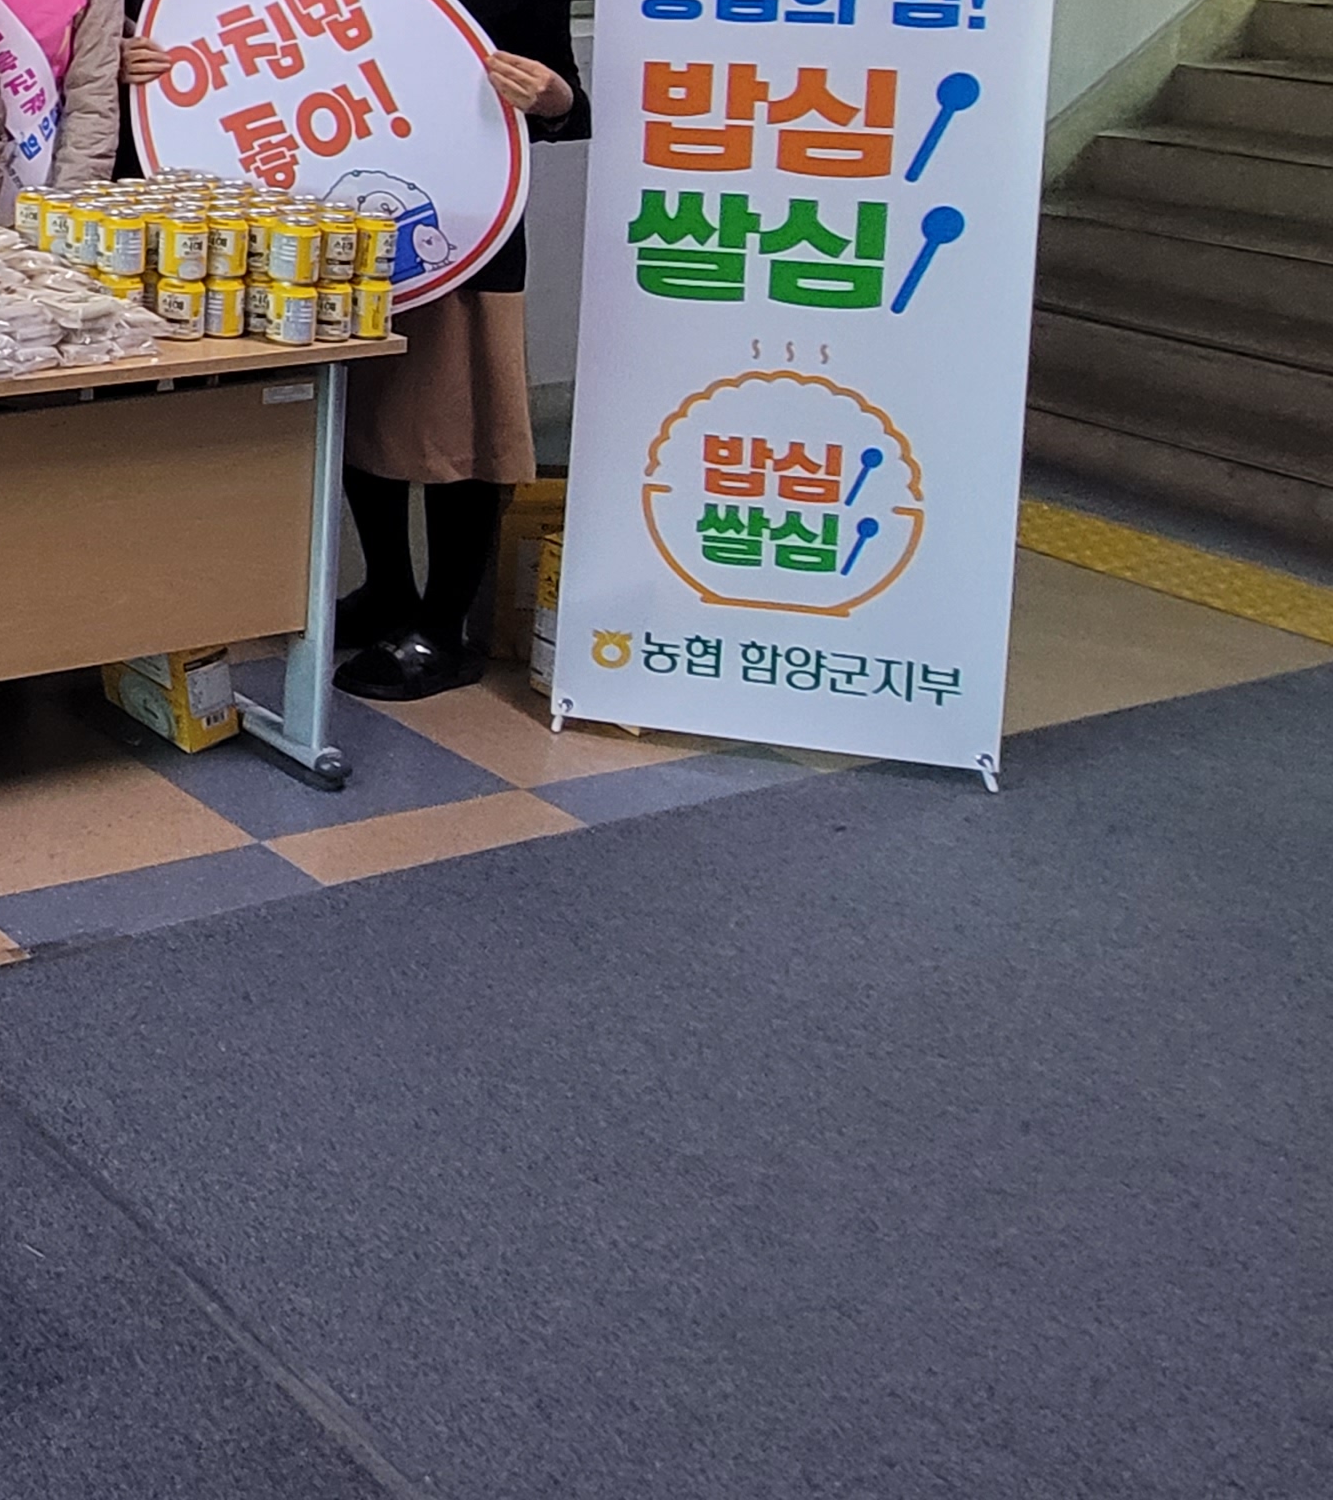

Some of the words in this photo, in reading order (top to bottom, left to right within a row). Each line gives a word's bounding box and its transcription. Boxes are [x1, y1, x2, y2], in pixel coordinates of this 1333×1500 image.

[219, 58, 412, 190] 좋아!
[641, 61, 898, 179] 밥심
[628, 189, 888, 310] 쌀심
[703, 434, 843, 504] 밥심
[696, 503, 840, 573] 쌀심
[641, 631, 722, 679] 농협
[739, 641, 963, 706] 함양군지부
